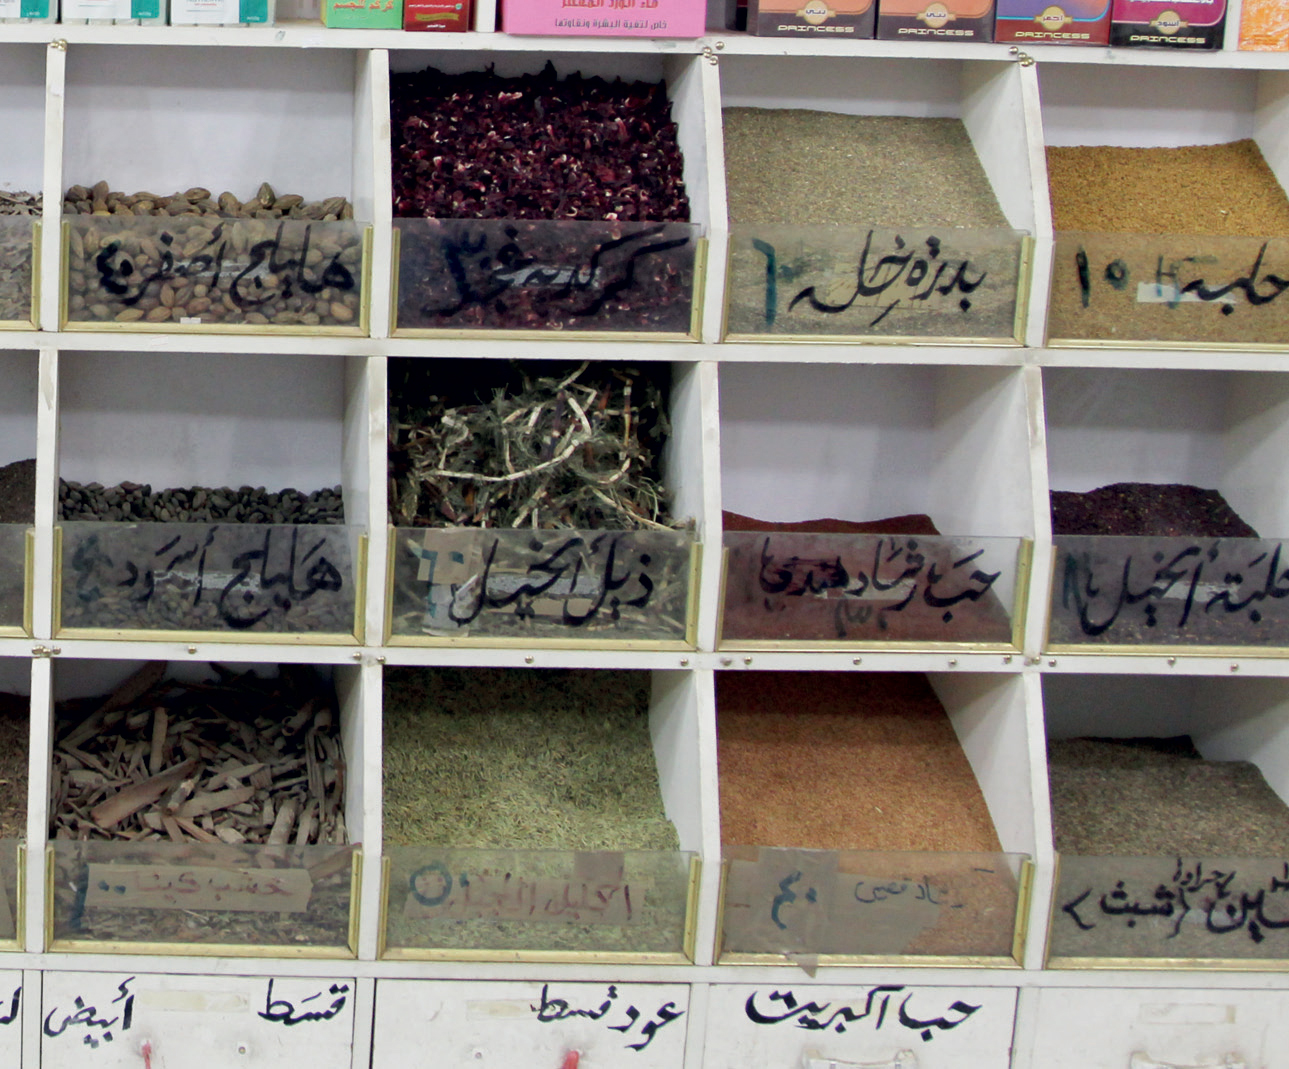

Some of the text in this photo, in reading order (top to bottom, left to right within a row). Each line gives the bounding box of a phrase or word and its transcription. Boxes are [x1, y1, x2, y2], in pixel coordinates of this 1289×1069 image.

[777, 24, 855, 34] PRINCESS
[897, 27, 975, 37] PRINCESS
[1014, 30, 1091, 41] PRINCESS
[1129, 34, 1207, 45] PRINCESS
